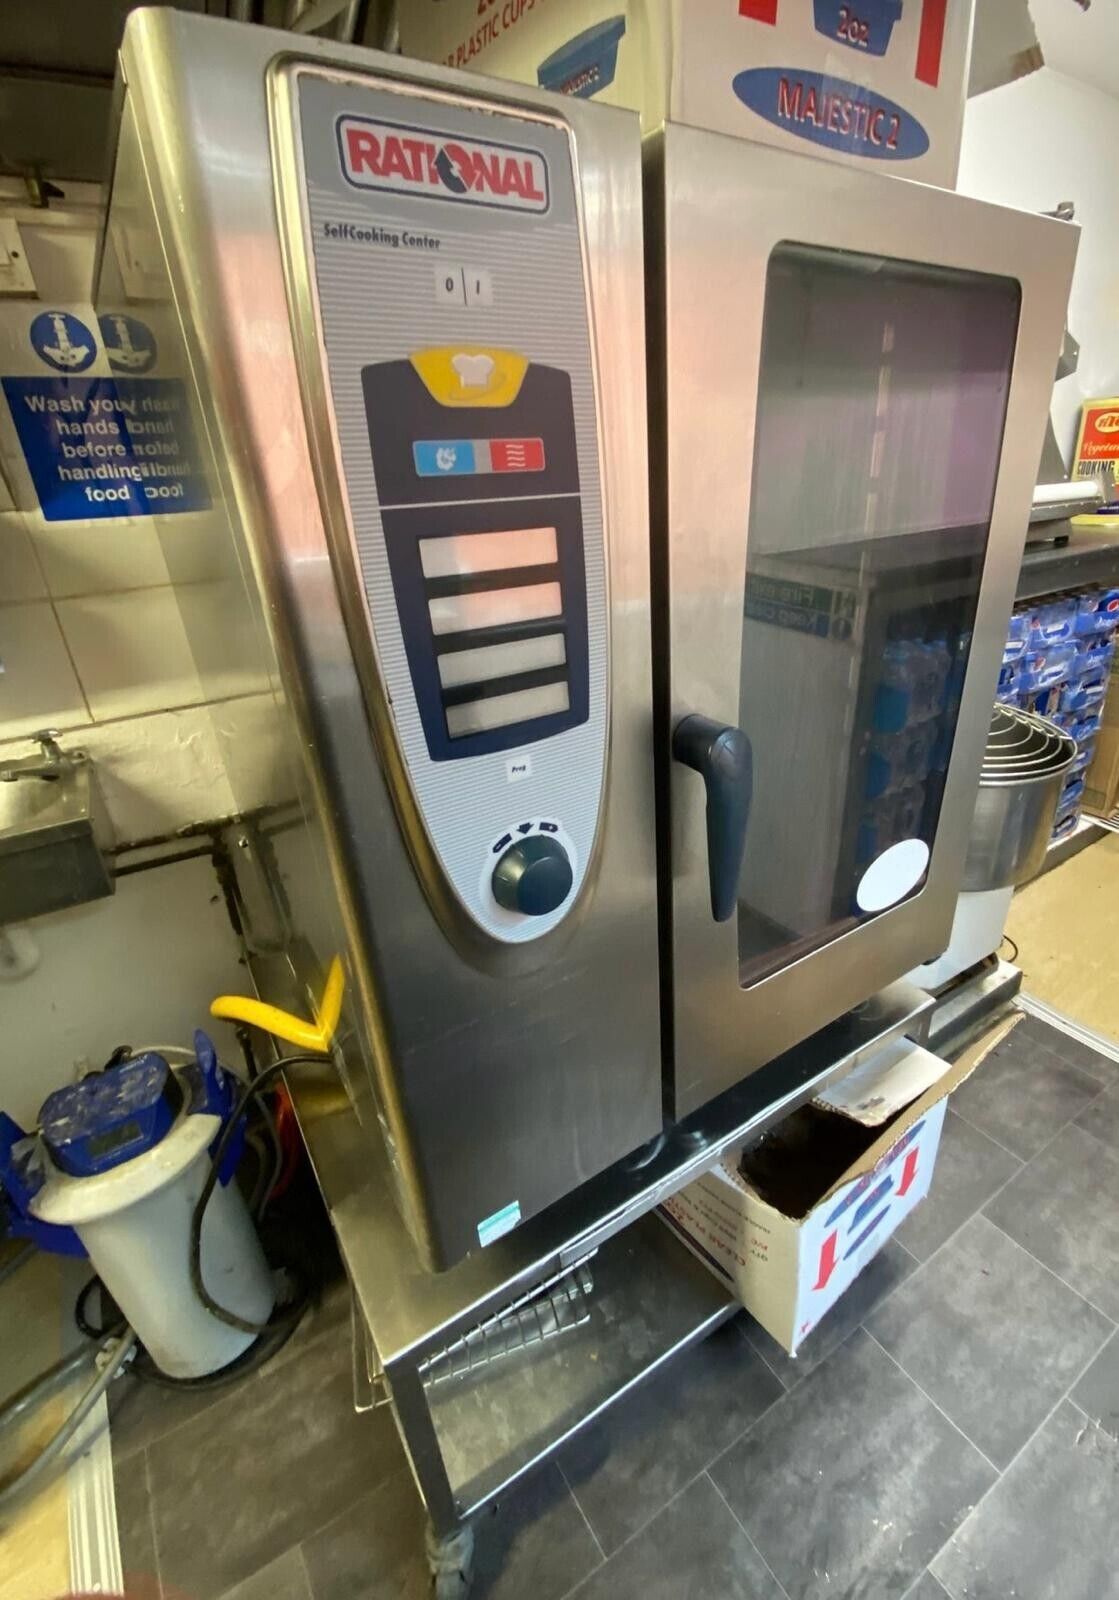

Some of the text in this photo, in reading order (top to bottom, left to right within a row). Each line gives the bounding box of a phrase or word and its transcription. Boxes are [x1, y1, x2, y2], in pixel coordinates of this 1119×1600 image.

[456, 12, 500, 69] PLASTIC
[777, 76, 900, 150] MAJESTIC 2
[345, 127, 545, 201] RATIONAL
[323, 223, 440, 249] SelfCooking Center
[24, 395, 85, 412] Wash
[56, 419, 120, 435] hands
[61, 441, 126, 458] before
[85, 484, 130, 501] food
